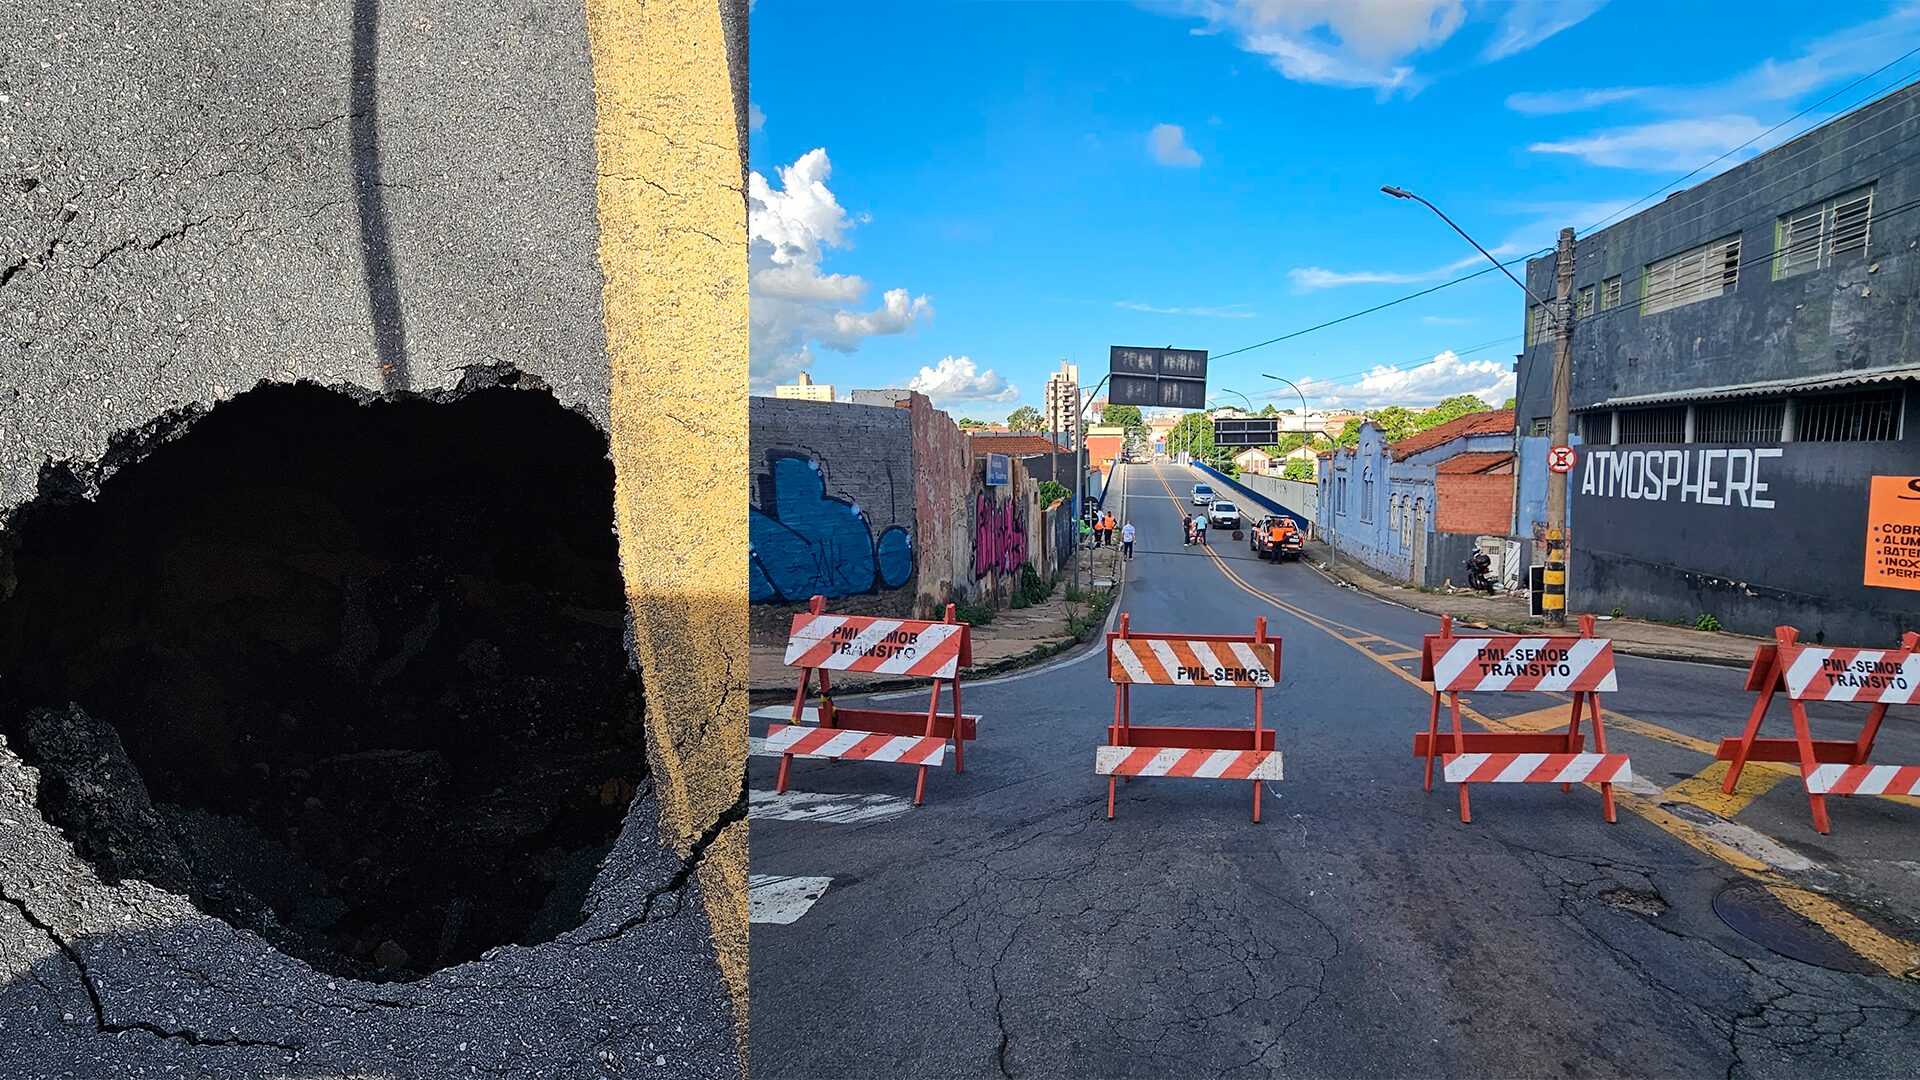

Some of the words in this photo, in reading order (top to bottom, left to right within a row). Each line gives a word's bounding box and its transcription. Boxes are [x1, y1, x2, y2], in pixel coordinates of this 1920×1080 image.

[1582, 448, 1783, 509] ATMOSPHERE
[1885, 557, 1920, 569] INOX
[1477, 648, 1569, 662] PML-SEMOB
[1177, 666, 1270, 683] PML-SEMOB
[1479, 661, 1570, 677] TRÂNSITO
[1822, 658, 1904, 675] PML-SEMOB
[1825, 672, 1908, 690] TRÂNSITO
